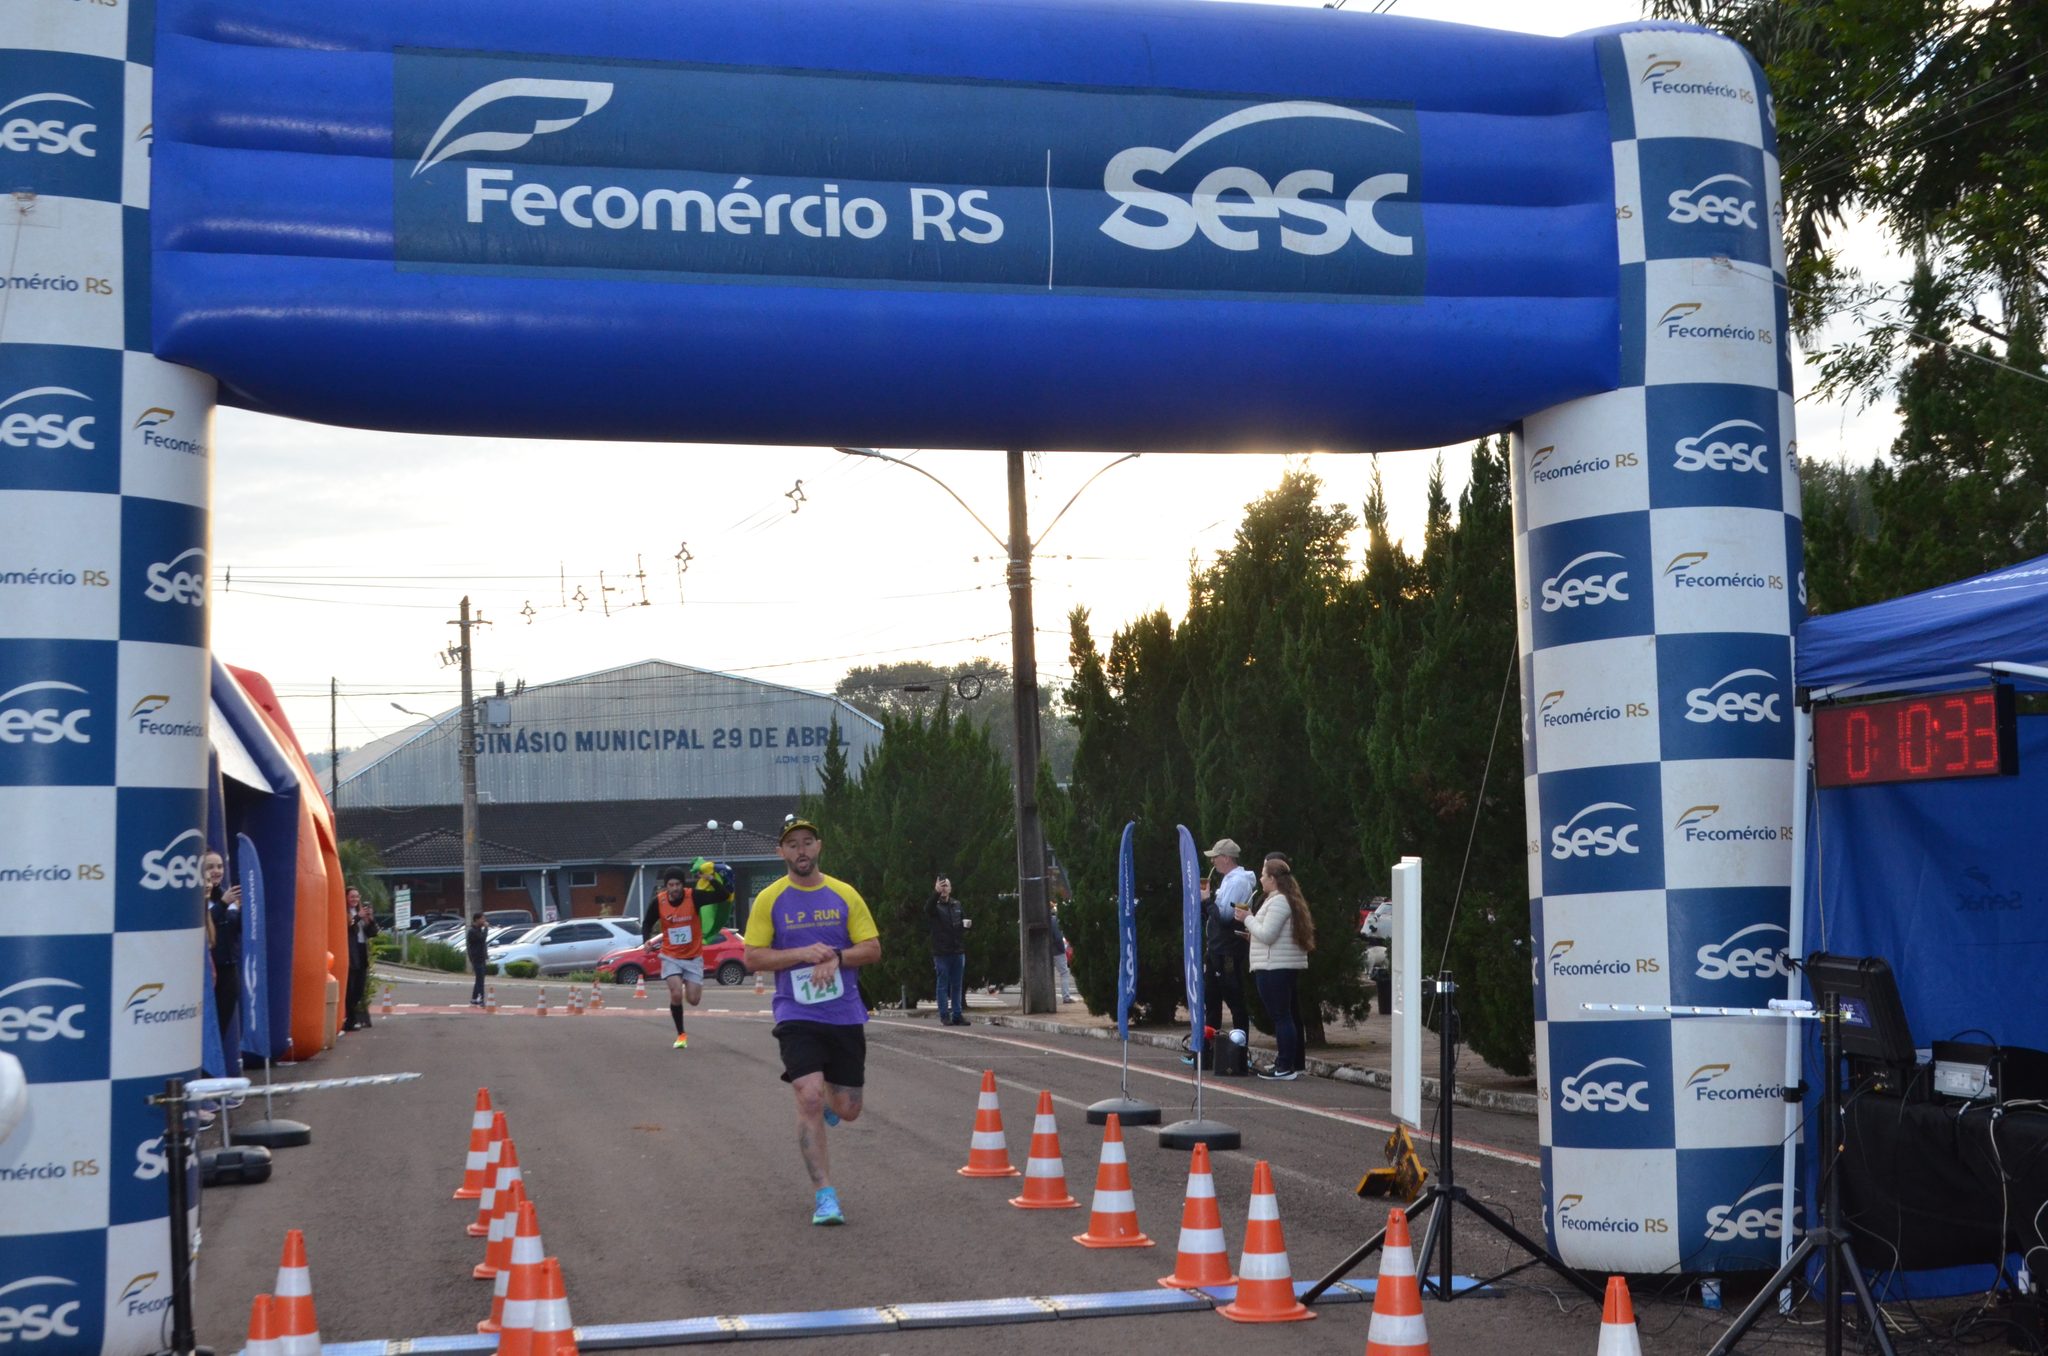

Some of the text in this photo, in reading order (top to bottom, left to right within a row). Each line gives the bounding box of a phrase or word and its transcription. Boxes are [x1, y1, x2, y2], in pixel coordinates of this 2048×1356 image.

[1653, 78, 1754, 104] Fecomércio RS
[0, 92, 97, 157] esc
[1099, 100, 1415, 256] Sesc
[464, 167, 1004, 245] Fecomércio RS
[1667, 173, 1759, 229] Sesc
[85, 277, 112, 294] RS
[1668, 324, 1772, 344] Fecomércio RS
[0, 386, 95, 450] esc
[1673, 419, 1768, 474] Sesc
[1534, 453, 1639, 484] Fecomércio RS
[82, 570, 109, 588] RS
[144, 548, 208, 607] Ses
[1541, 551, 1629, 612] Sesc
[1675, 572, 1764, 588] Fecomércio
[1768, 574, 1783, 590] RS
[0, 680, 90, 744] esc
[1544, 703, 1649, 728] Fecomércio RS
[1685, 669, 1781, 723] Sesc
[475, 726, 850, 754] GINÁSIO MUNICIPAL 29 DE ABRL
[1551, 802, 1639, 860] Sesc
[1686, 825, 1777, 842] Fecomércio
[0, 864, 104, 881] mércio RS
[814, 909, 840, 921] RUN
[674, 933, 687, 943] 72
[1553, 958, 1660, 976] Fecomércio RS
[0, 977, 86, 1041] esc
[1560, 1057, 1649, 1112] Sesc
[0, 1160, 99, 1180] mércio RS
[1561, 1214, 1668, 1233] Fecomércio RS
[1704, 1182, 1803, 1242] Sesc
[0, 1276, 80, 1341] esc
